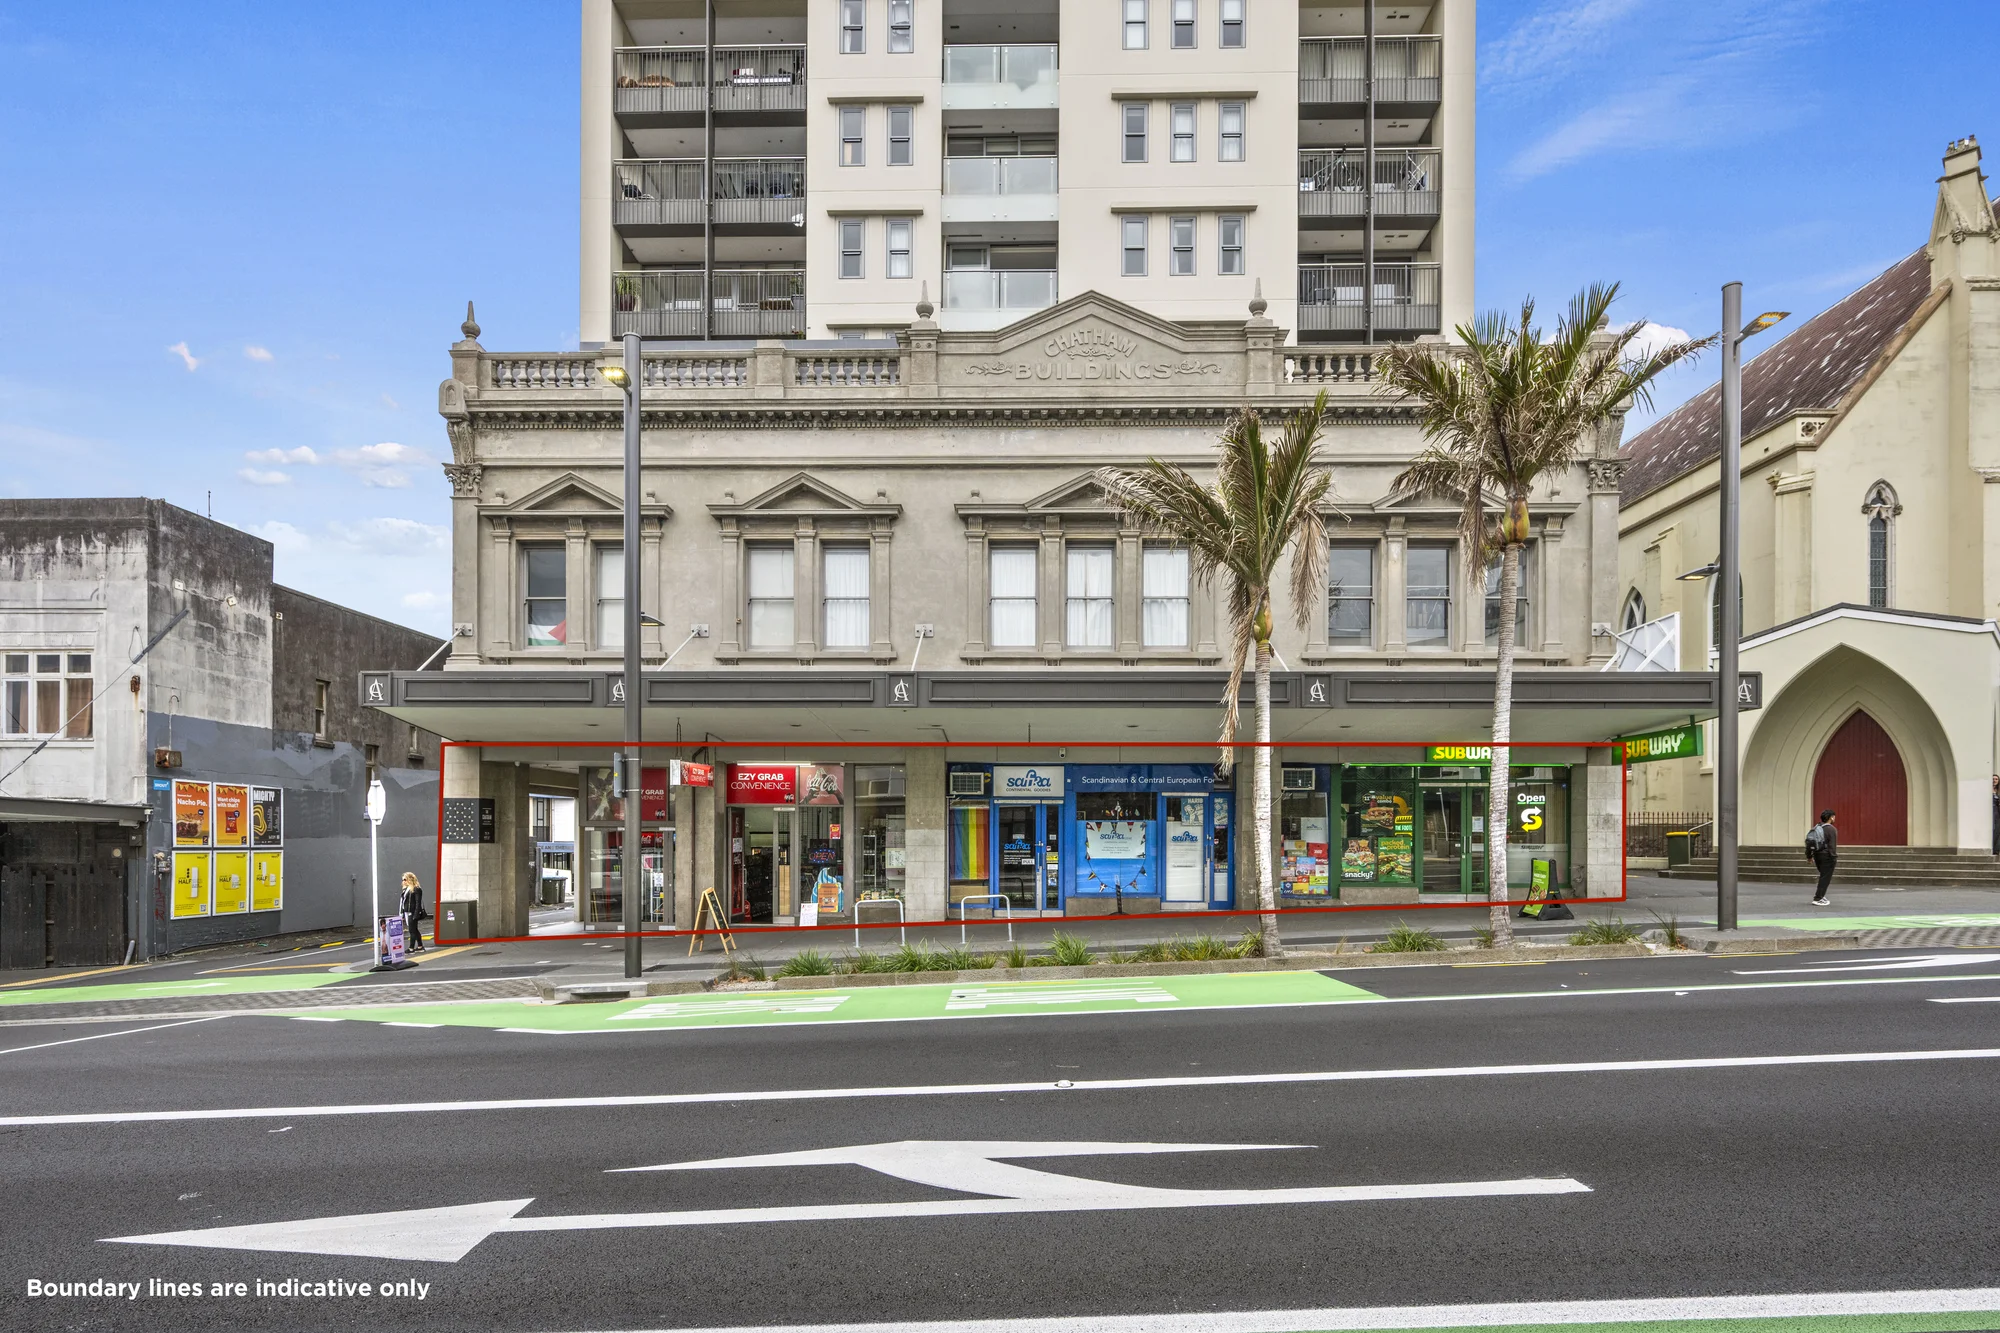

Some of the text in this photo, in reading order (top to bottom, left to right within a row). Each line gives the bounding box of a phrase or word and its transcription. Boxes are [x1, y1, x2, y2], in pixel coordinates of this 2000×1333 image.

[1043, 328, 1138, 357] CHATHAM
[1015, 363, 1173, 380] BUILDINGS
[1626, 732, 1685, 758] SUBWAY
[1433, 746, 1492, 760] SUBWA
[738, 773, 784, 781] EZY GRAB
[1081, 776, 1129, 784] Scandinavian
[1130, 776, 1137, 784] &
[1138, 776, 1165, 784] Central
[1167, 776, 1202, 786] European
[731, 782, 791, 790] CONVENIENCE
[1517, 793, 1545, 804] Open
[808, 851, 836, 860] OPEN
[1345, 871, 1374, 879] snacky?
